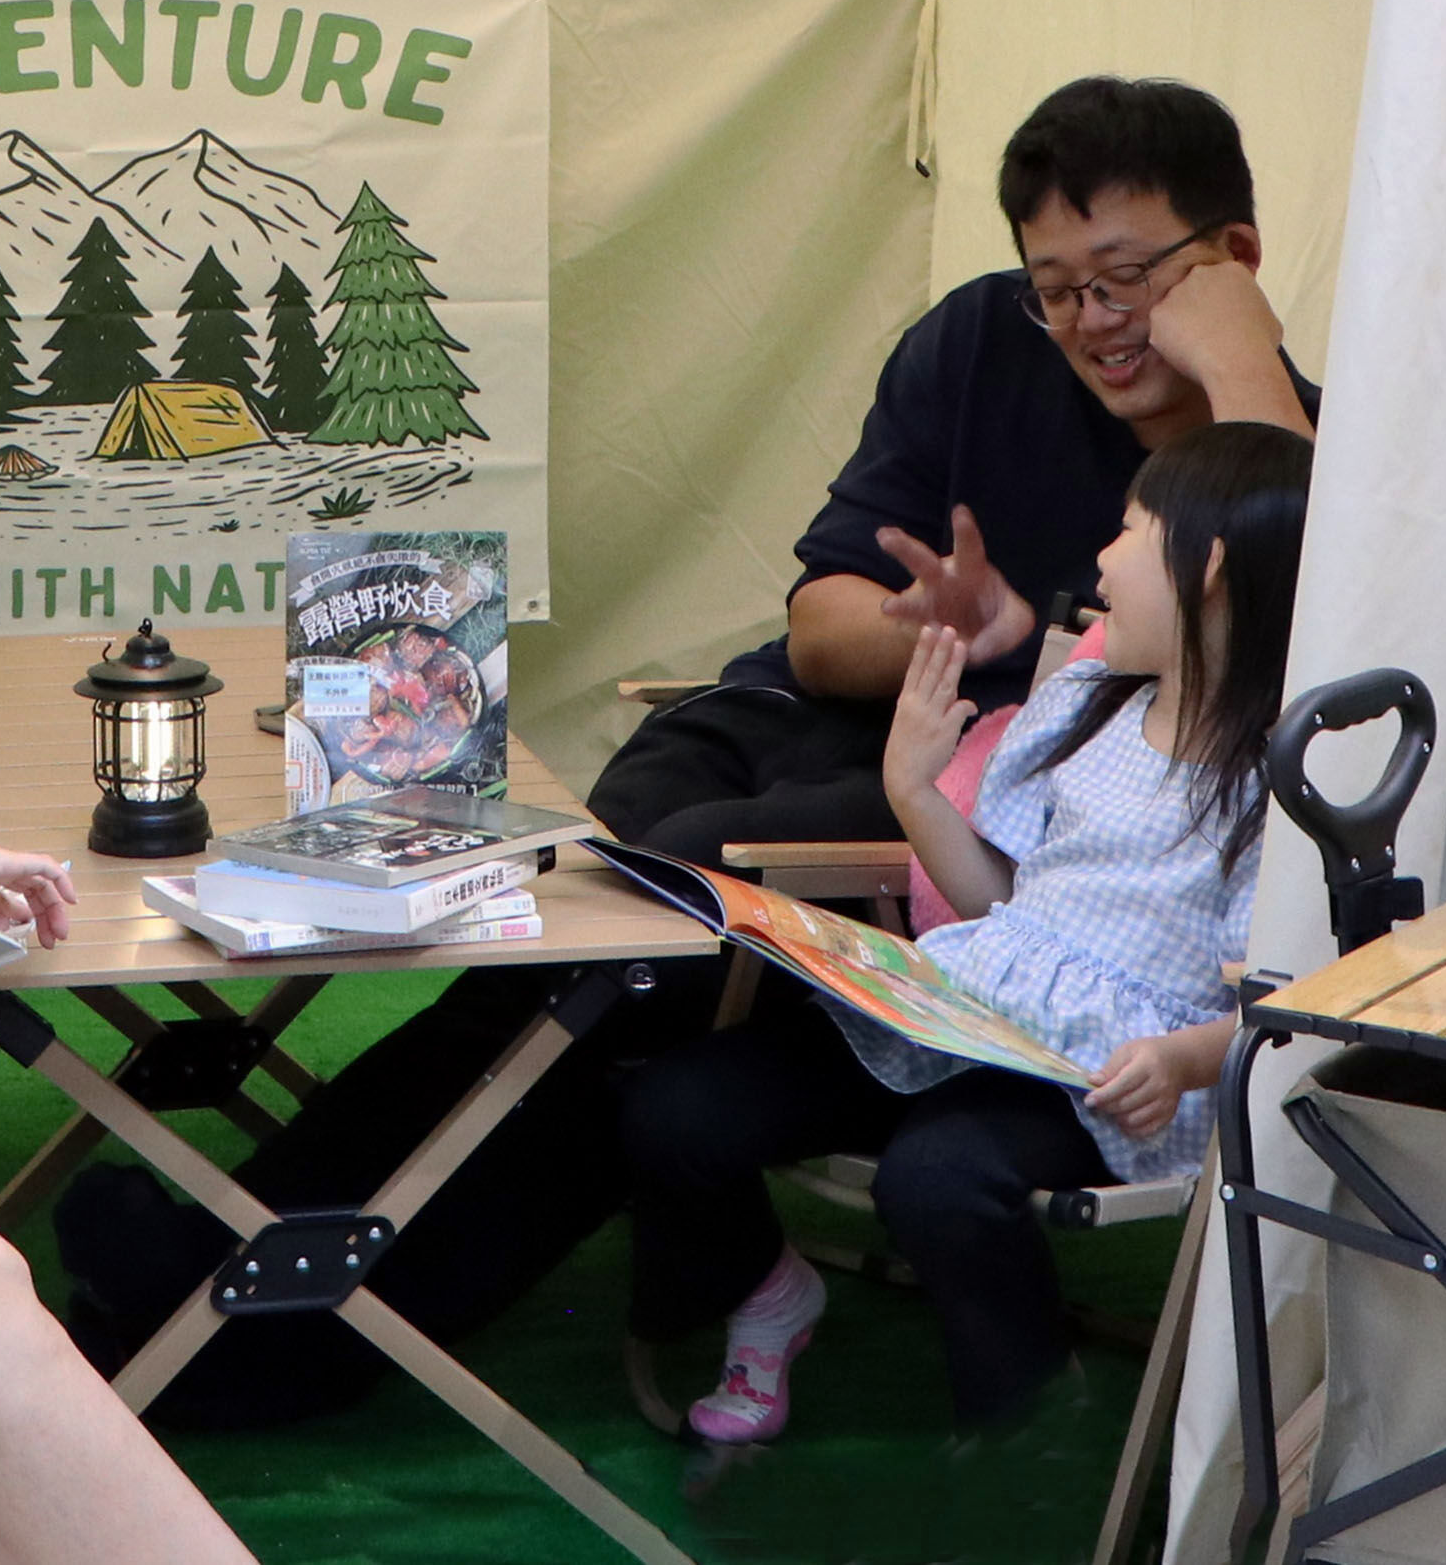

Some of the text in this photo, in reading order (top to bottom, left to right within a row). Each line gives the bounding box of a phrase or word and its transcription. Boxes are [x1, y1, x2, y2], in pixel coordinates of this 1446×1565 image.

[297, 580, 453, 647] 露營野炊食
